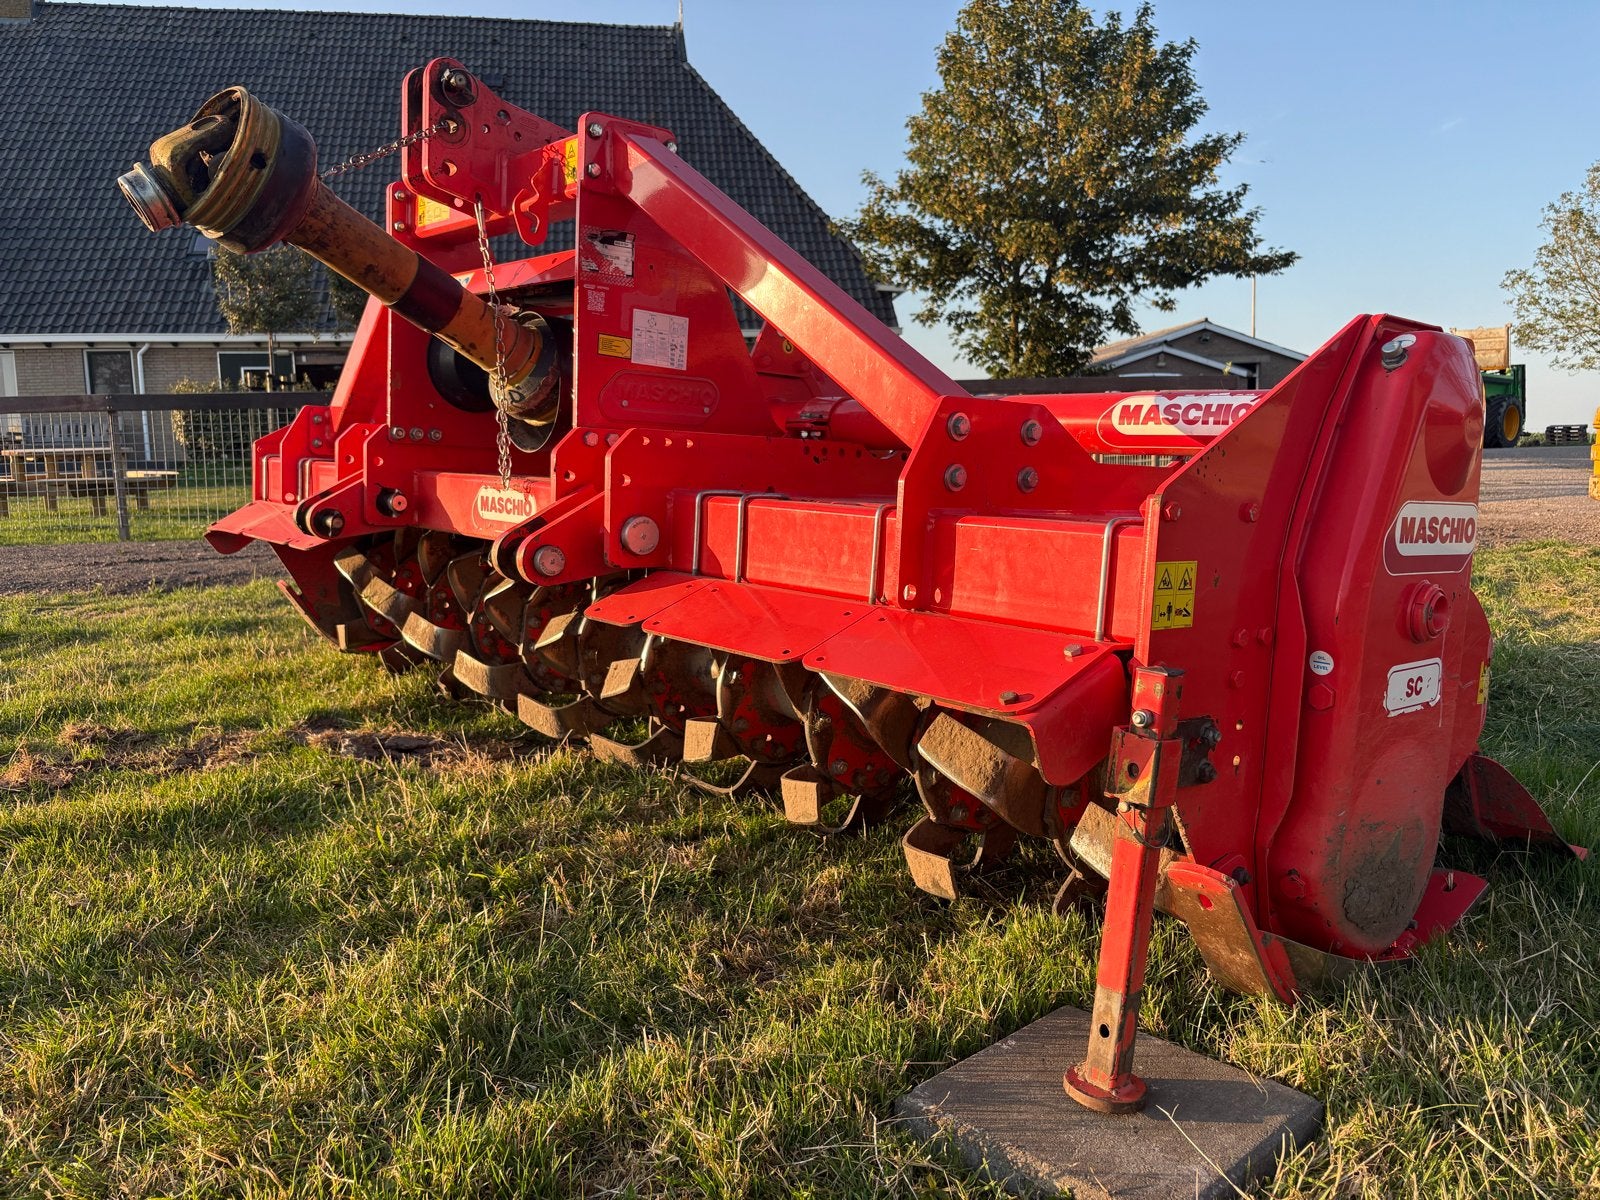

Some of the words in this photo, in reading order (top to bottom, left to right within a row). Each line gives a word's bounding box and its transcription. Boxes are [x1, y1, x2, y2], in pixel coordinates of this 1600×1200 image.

[618, 383, 714, 405] MASCHIO
[480, 495, 532, 517] MASCHIO
[1399, 516, 1476, 544] MASCHIO
[1405, 675, 1424, 698] SC
